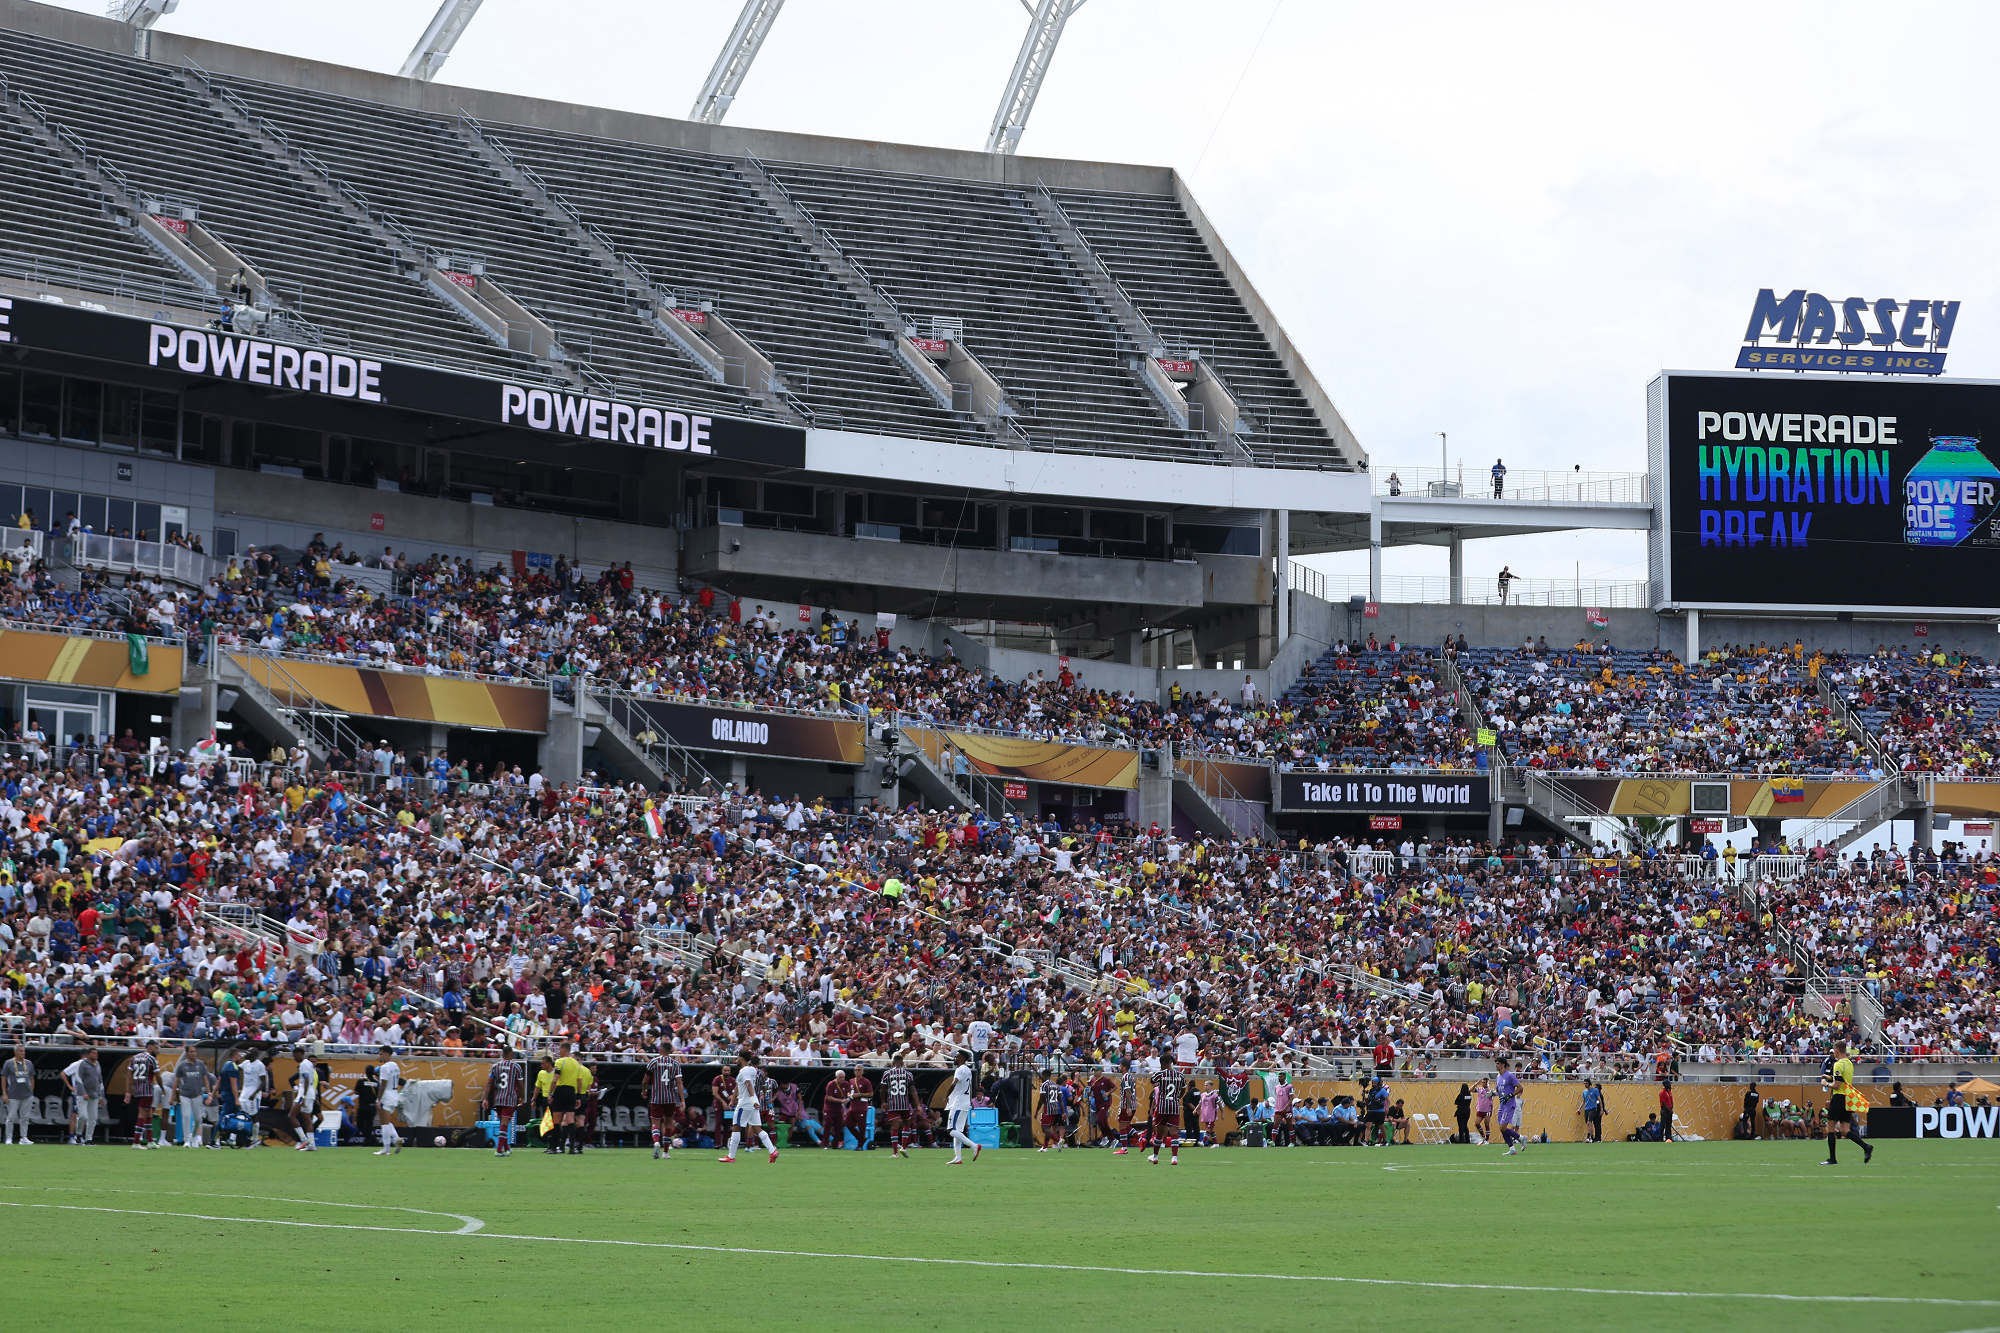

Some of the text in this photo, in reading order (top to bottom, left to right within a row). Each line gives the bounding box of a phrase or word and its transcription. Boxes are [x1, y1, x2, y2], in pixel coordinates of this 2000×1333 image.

[1744, 288, 1961, 349] MASSEY
[149, 323, 382, 402] POWERADE
[1748, 352, 1935, 369] SERVICES INC.
[502, 383, 712, 455] POWERADE
[1698, 411, 1897, 444] POWERADE
[118, 467, 132, 476] C36
[1699, 445, 1890, 505] HYDRATION
[1906, 480, 1995, 505] POWER
[372, 517, 384, 525] P37
[1906, 504, 1951, 528] ADE
[1700, 509, 1813, 548] BREAK
[799, 609, 810, 619] P39
[1365, 606, 1377, 614] P41
[1587, 611, 1600, 619] P42
[1915, 625, 1927, 634] P43
[712, 718, 769, 745] ORLANDO
[1302, 782, 1470, 804] Take It To The World
[976, 1028, 987, 1038] 22
[132, 1063, 147, 1080] 22
[660, 1069, 670, 1086] 4
[499, 1072, 508, 1089] 3
[890, 1080, 906, 1096] 35
[1049, 1090, 1058, 1102] 21
[1166, 1083, 1176, 1100] 2
